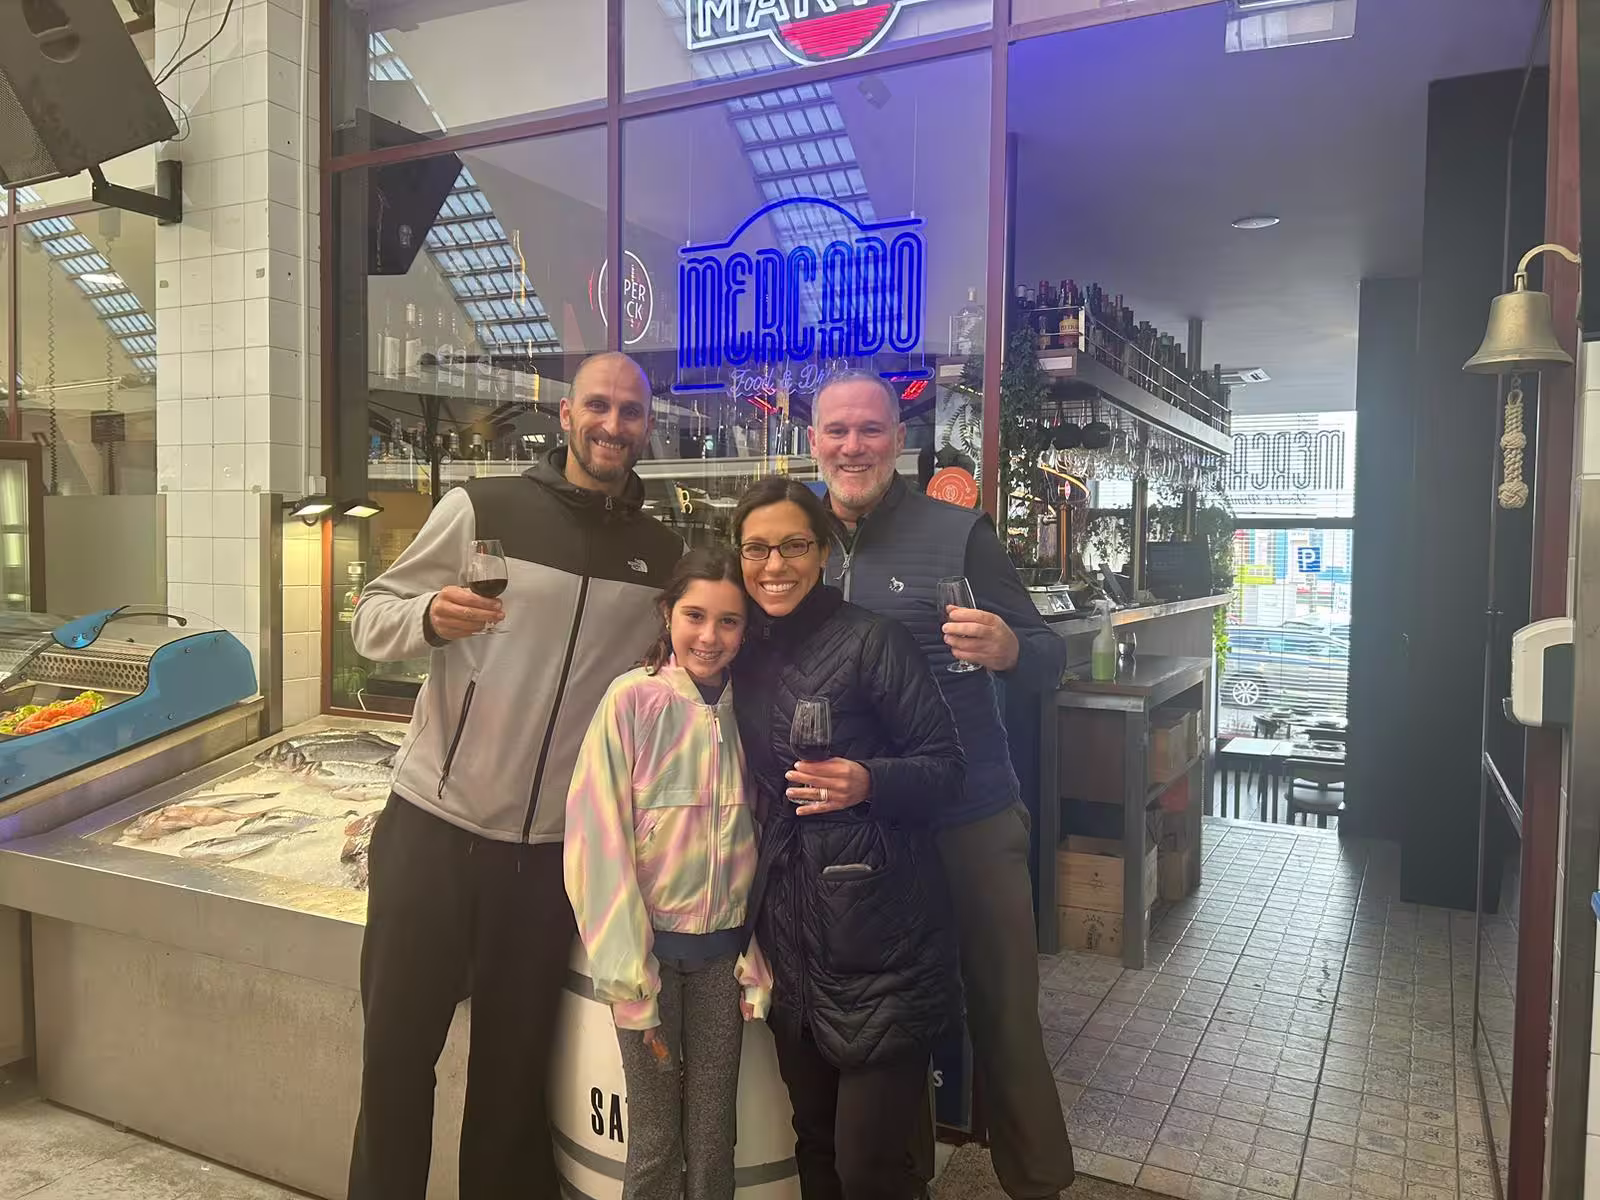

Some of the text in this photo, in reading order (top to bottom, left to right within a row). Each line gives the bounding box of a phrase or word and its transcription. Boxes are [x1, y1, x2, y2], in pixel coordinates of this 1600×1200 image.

[697, 0, 869, 38] MA
[623, 279, 646, 302] PER
[679, 231, 923, 369] MERCADO
[622, 300, 643, 321] CK
[730, 367, 774, 392] Food
[1302, 548, 1316, 571] P
[590, 1086, 628, 1144] SA
